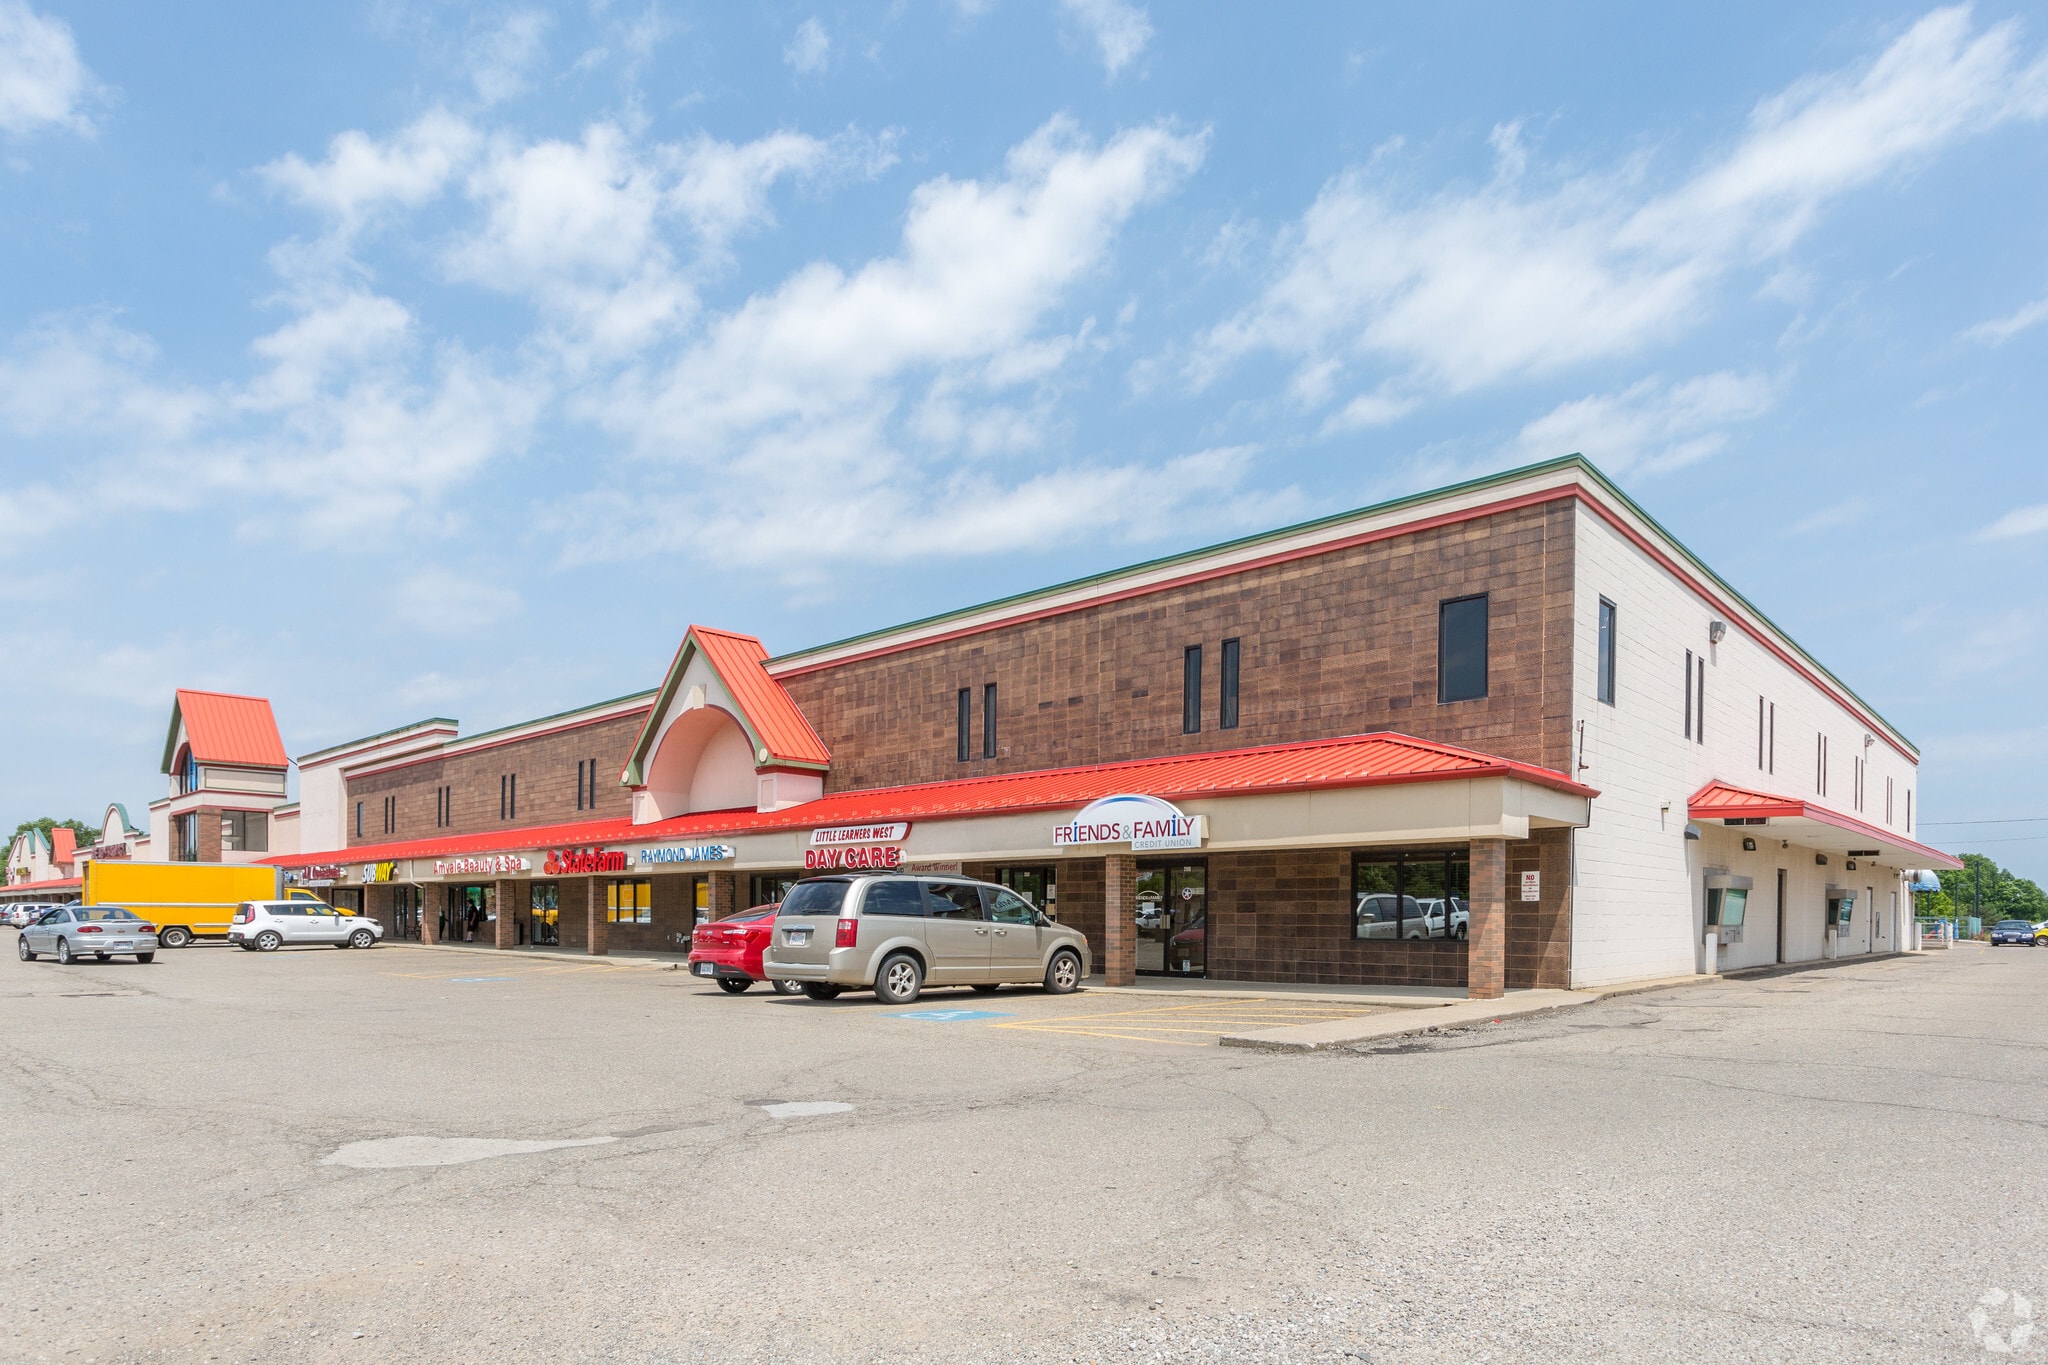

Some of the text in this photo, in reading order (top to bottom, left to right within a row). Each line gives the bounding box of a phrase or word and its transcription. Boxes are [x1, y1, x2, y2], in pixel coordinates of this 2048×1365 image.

[815, 826, 894, 842] LITTLE LEARNERS WEST
[1122, 825, 1132, 839] &
[1134, 838, 1192, 849] CREDIT UNION
[641, 845, 723, 863] RAYMOND JAMES
[805, 846, 898, 869] DAY CARE
[362, 861, 394, 883] SUBWAY
[464, 858, 493, 876] Beauty
[495, 856, 501, 871] &
[504, 855, 522, 874] Spa
[911, 863, 931, 872] Award
